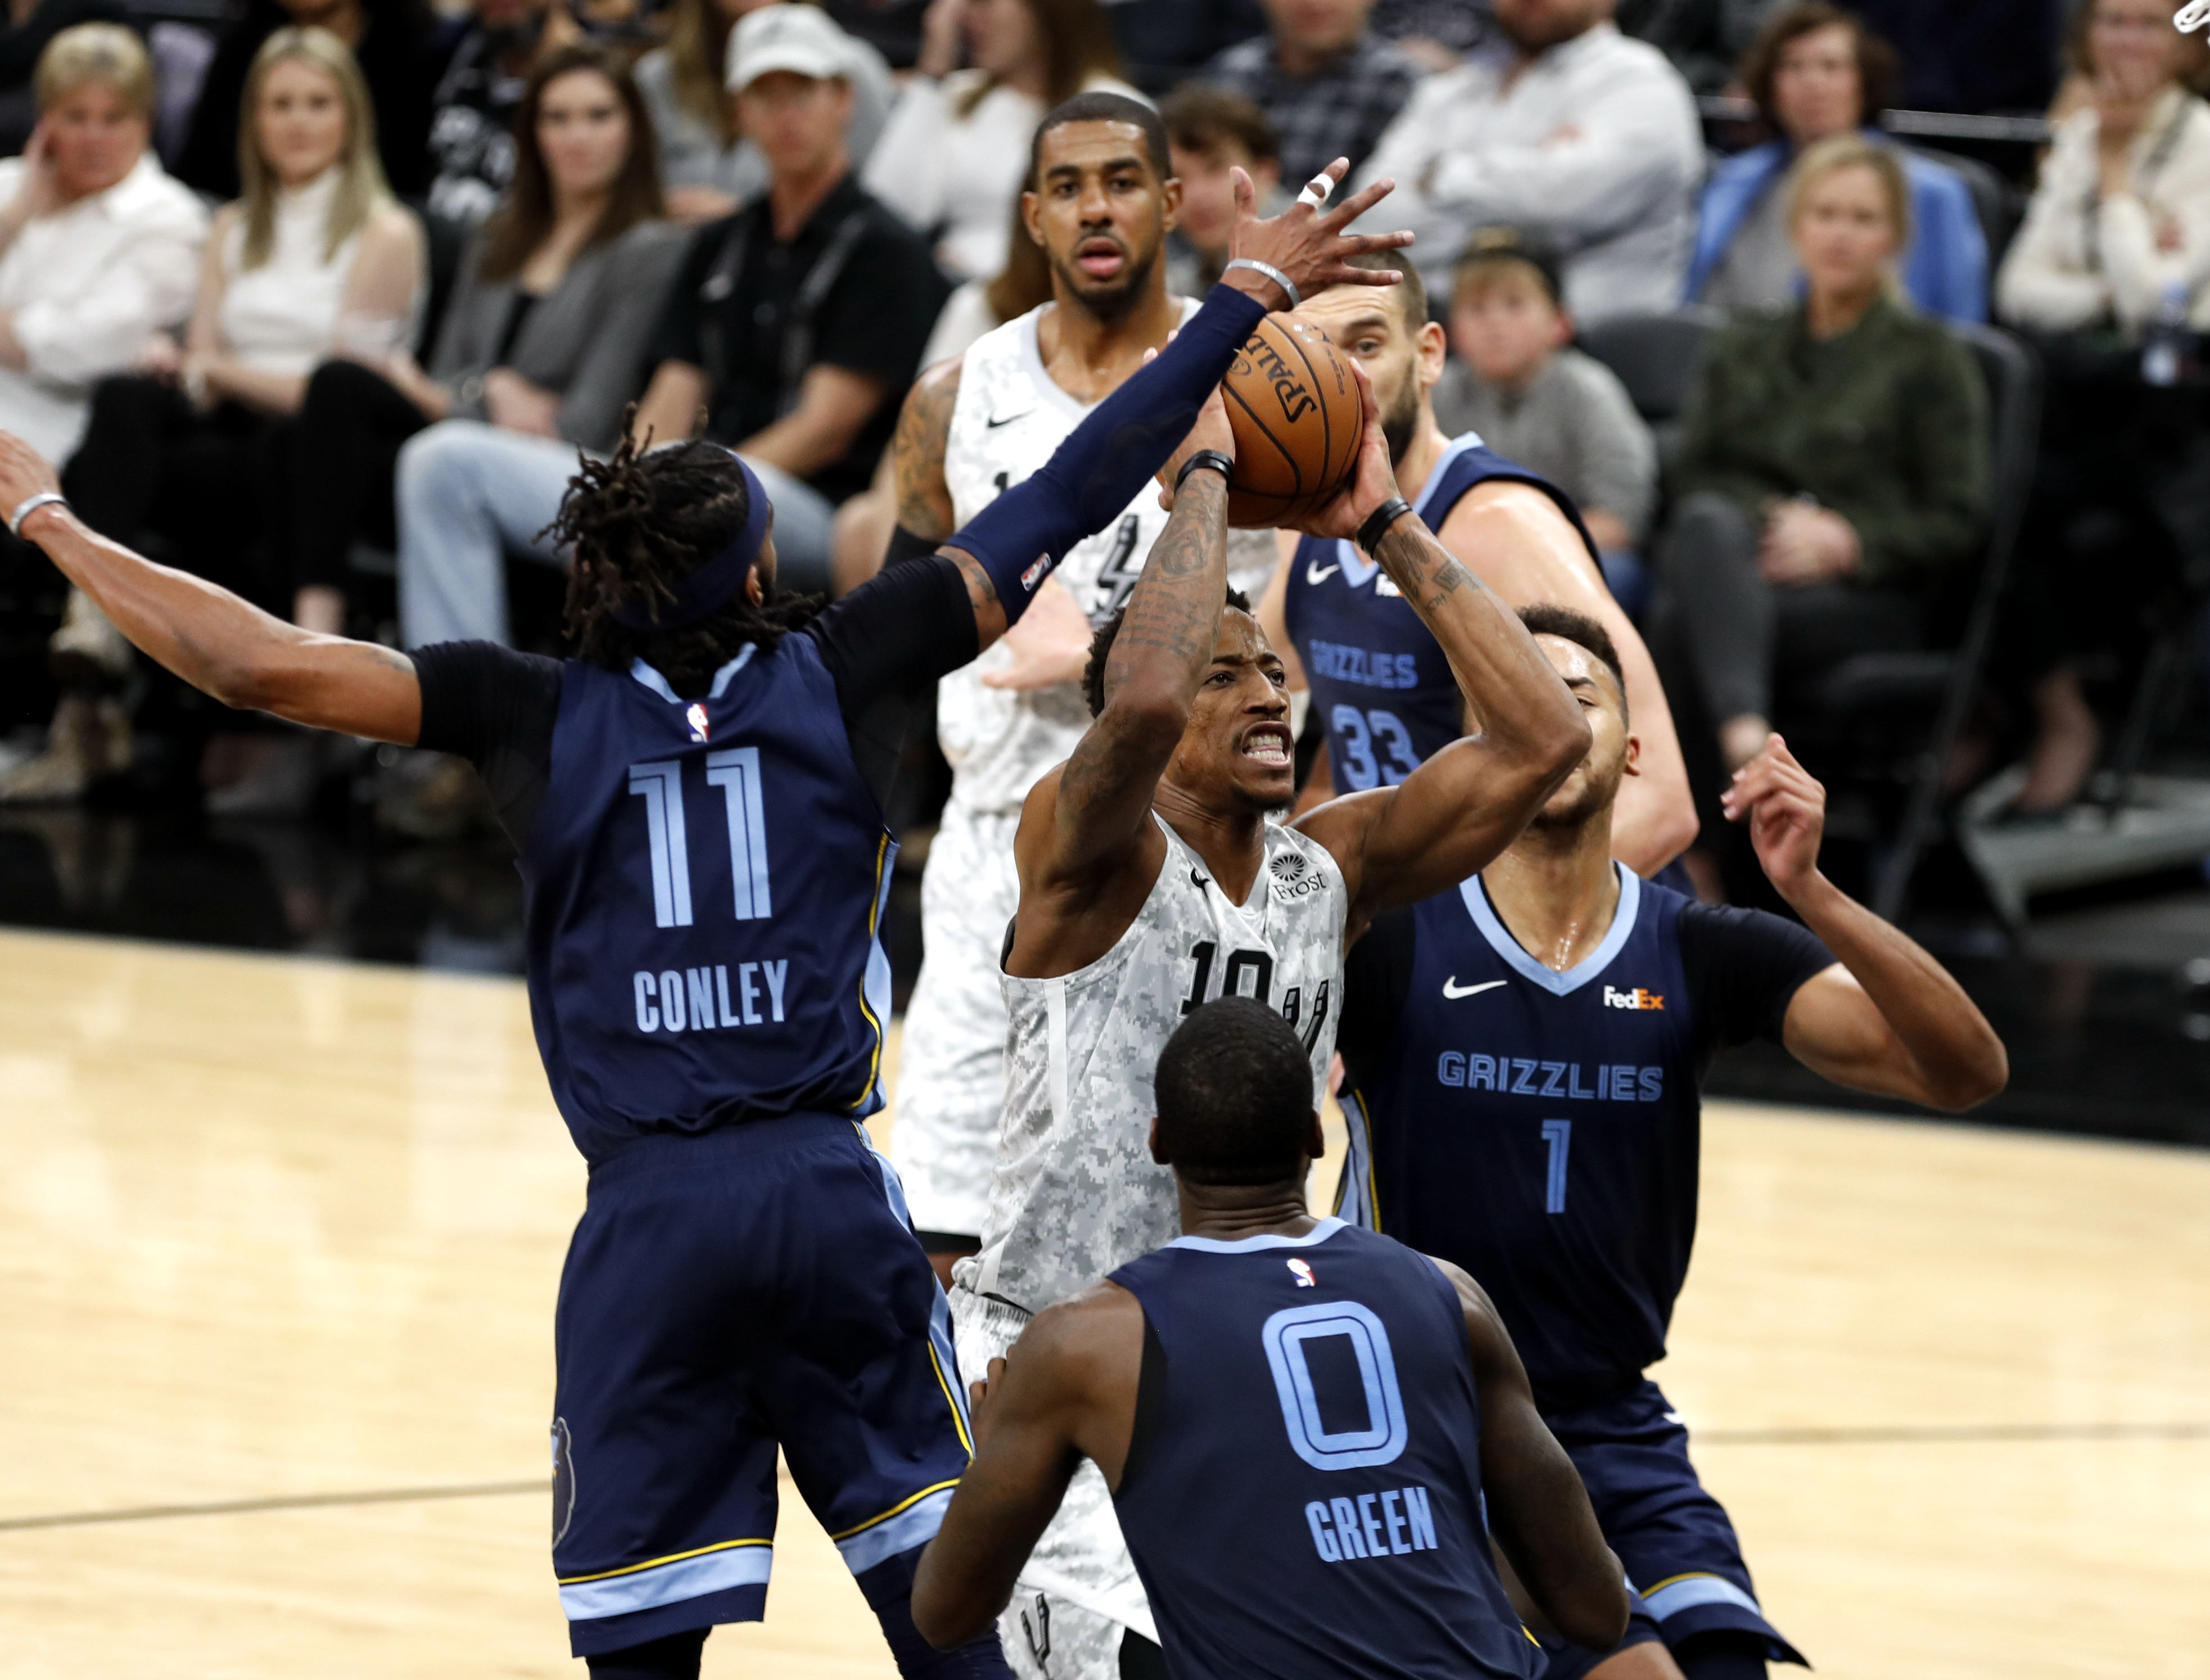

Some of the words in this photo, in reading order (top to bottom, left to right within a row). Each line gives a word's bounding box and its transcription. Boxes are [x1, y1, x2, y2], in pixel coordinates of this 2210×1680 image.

[1331, 703, 1422, 792] 33
[629, 746, 772, 928] 11
[1273, 870, 1327, 900] Frost
[633, 959, 788, 1033] CONLEY
[1179, 940, 1275, 1017] 10
[1603, 985, 1665, 1010] FedEx
[1438, 1050, 1664, 1102] GRIZZLIES
[1541, 1119, 1571, 1214] 1
[1262, 1300, 1409, 1471] 0
[1304, 1487, 1438, 1562] GREEN
